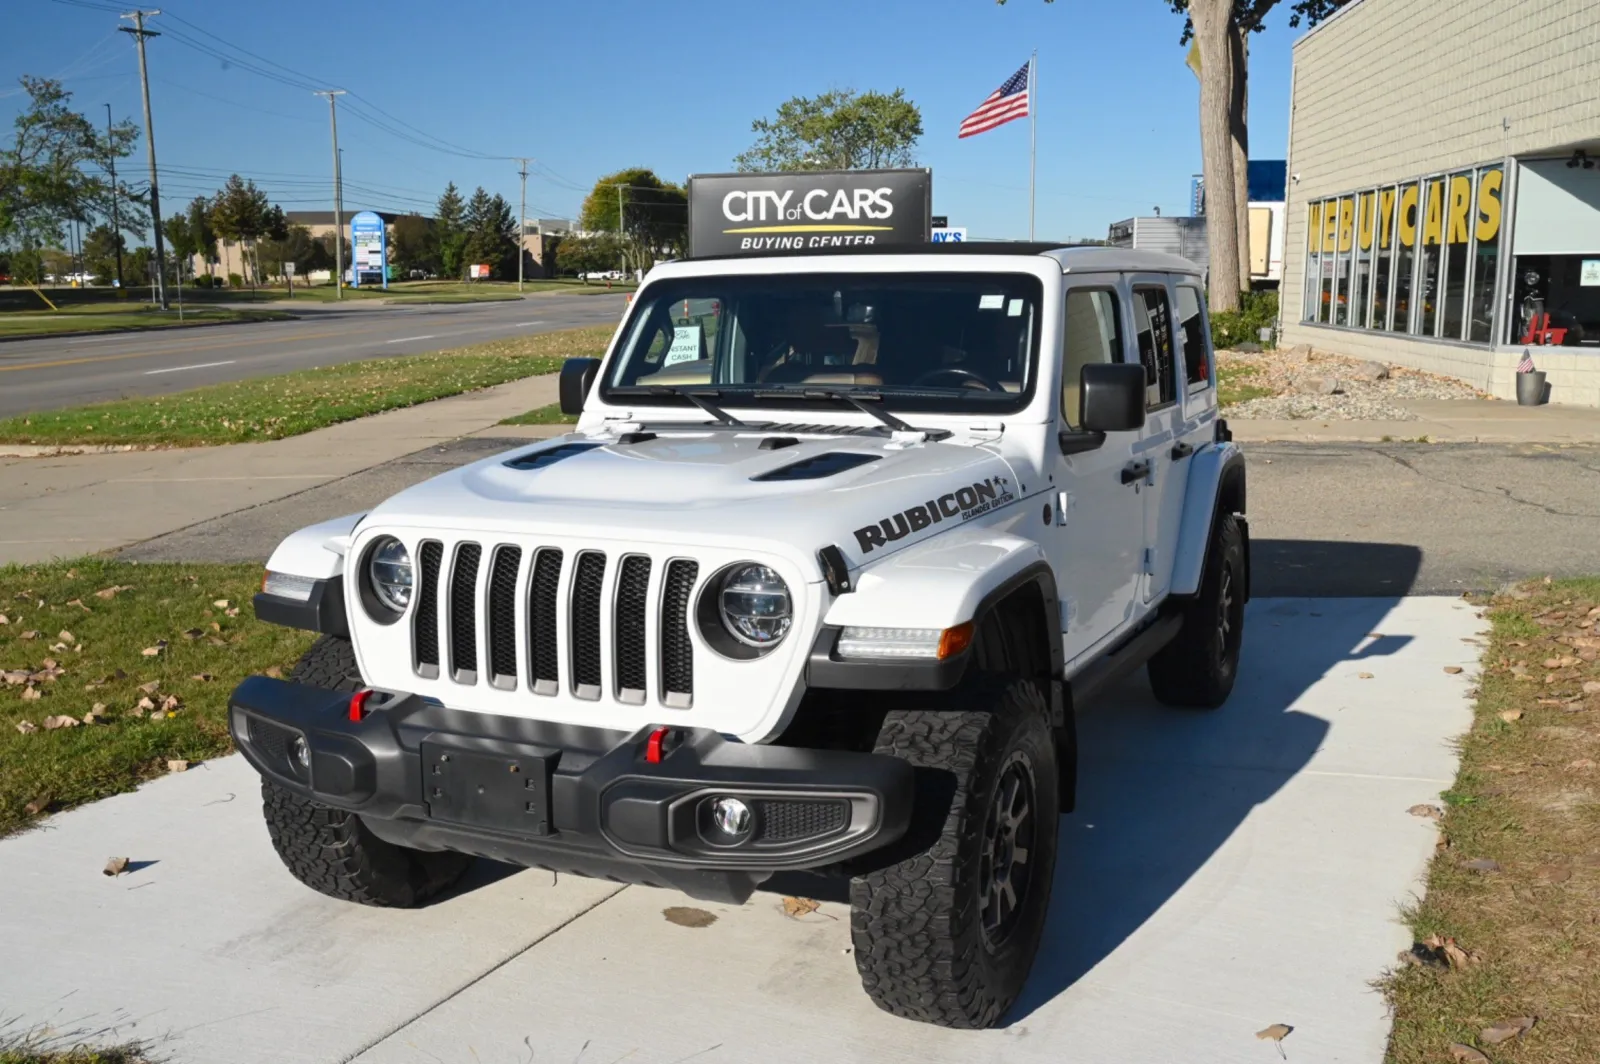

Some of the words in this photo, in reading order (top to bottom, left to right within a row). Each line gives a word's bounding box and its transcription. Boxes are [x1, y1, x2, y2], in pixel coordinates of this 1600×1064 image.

[722, 190, 794, 222] CITY
[786, 203, 802, 220] of
[803, 187, 894, 220] CARS
[741, 236, 804, 249] BUYING
[808, 235, 876, 248] CENTER
[671, 353, 692, 361] CASH
[853, 478, 997, 554] RUBICON
[961, 502, 991, 520] ISLANDER
[991, 493, 1014, 508] EDITION
